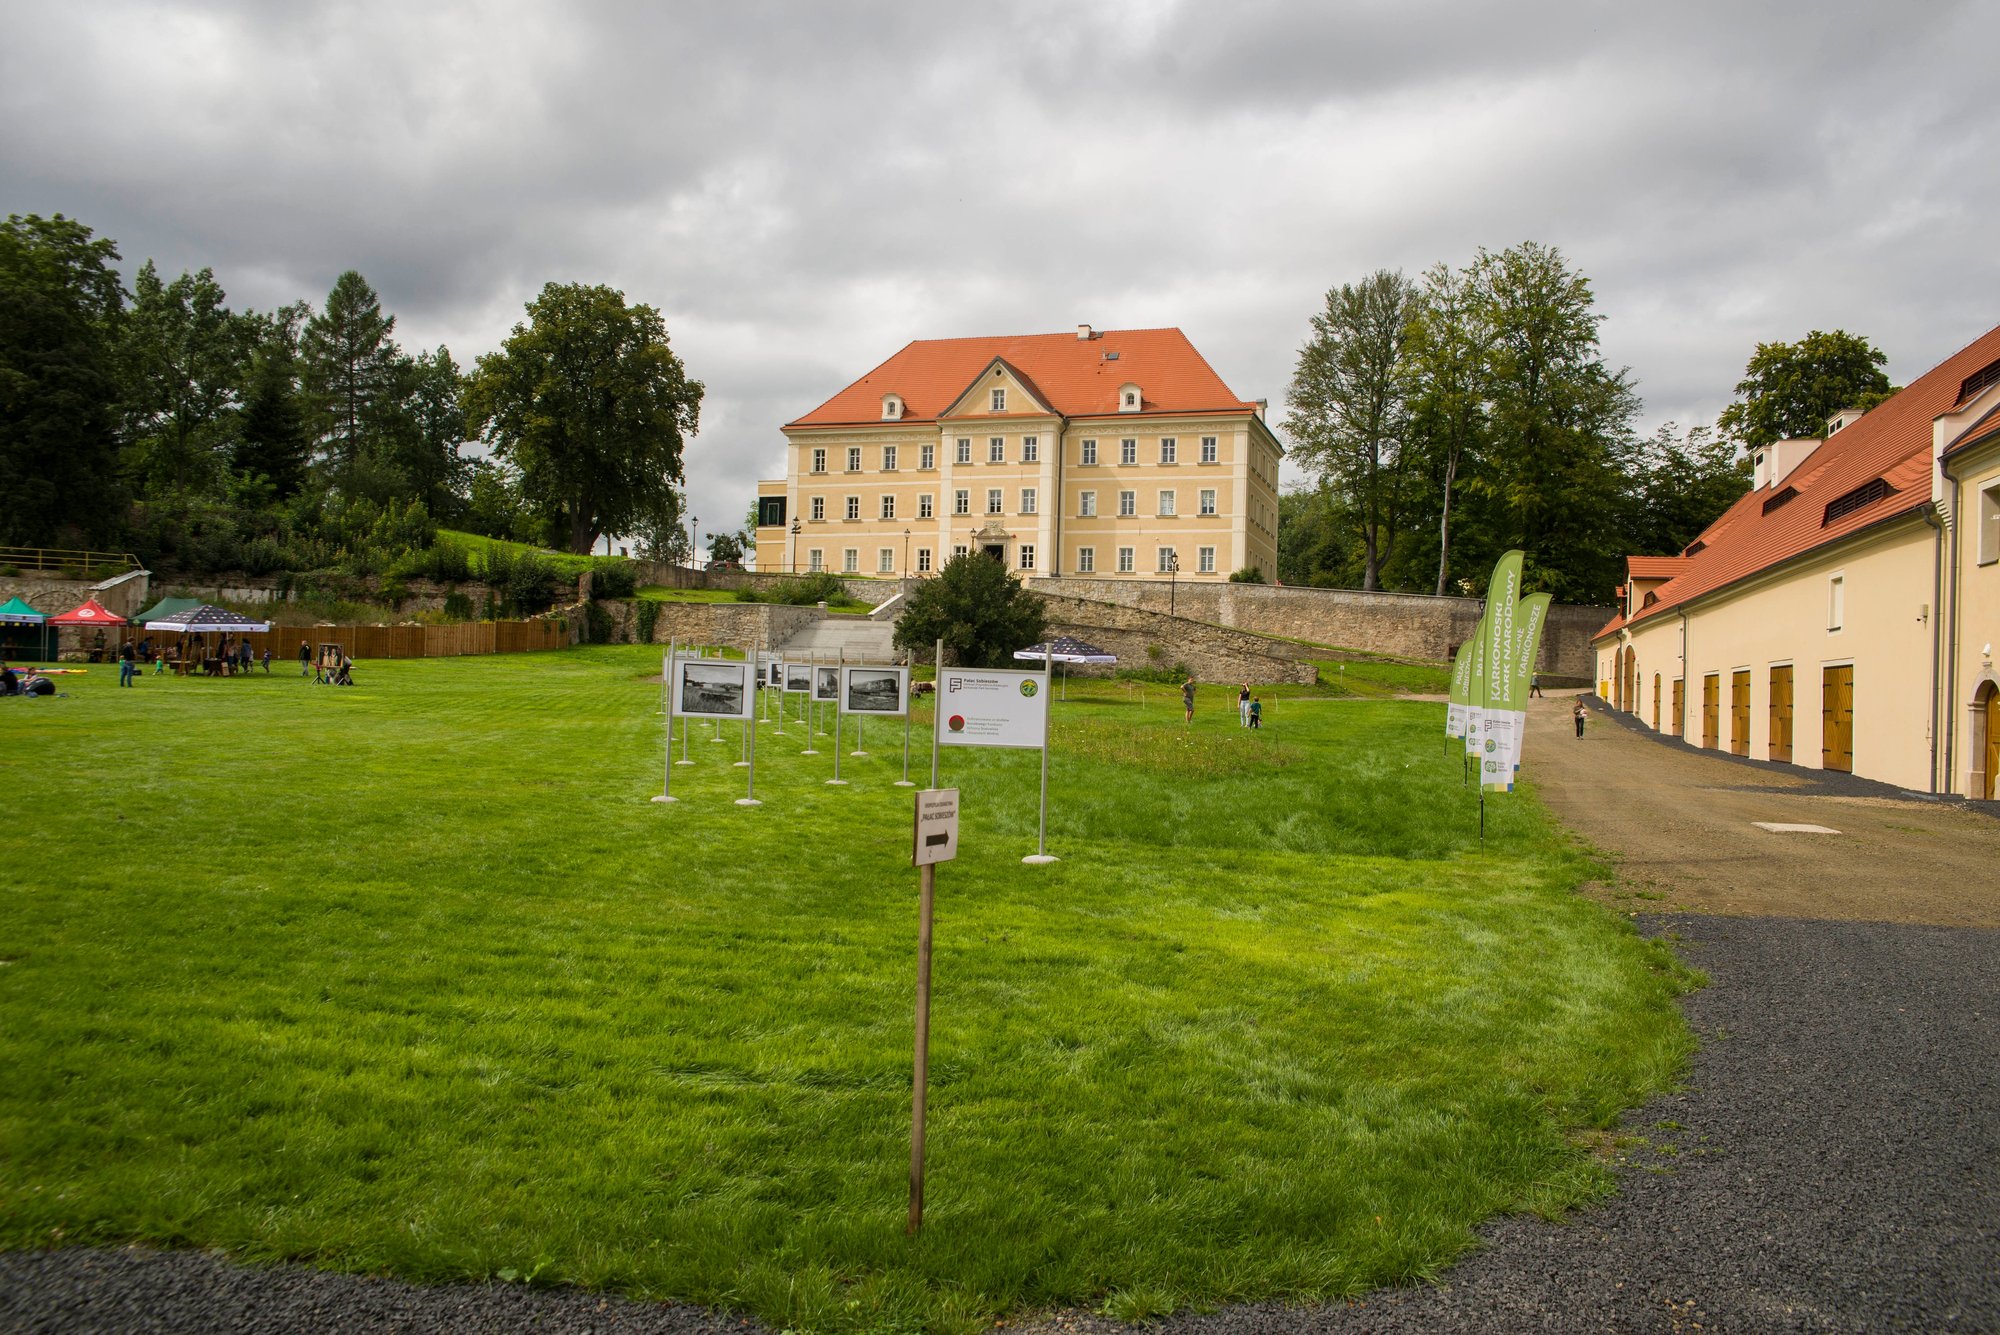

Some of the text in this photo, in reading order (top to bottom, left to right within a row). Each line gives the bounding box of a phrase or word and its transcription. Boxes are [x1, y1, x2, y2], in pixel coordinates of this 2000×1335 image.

[1491, 602, 1502, 701] KARKONOSKI
[1503, 569, 1515, 660] NARODOWY
[1518, 604, 1541, 678] KARKONOSZE
